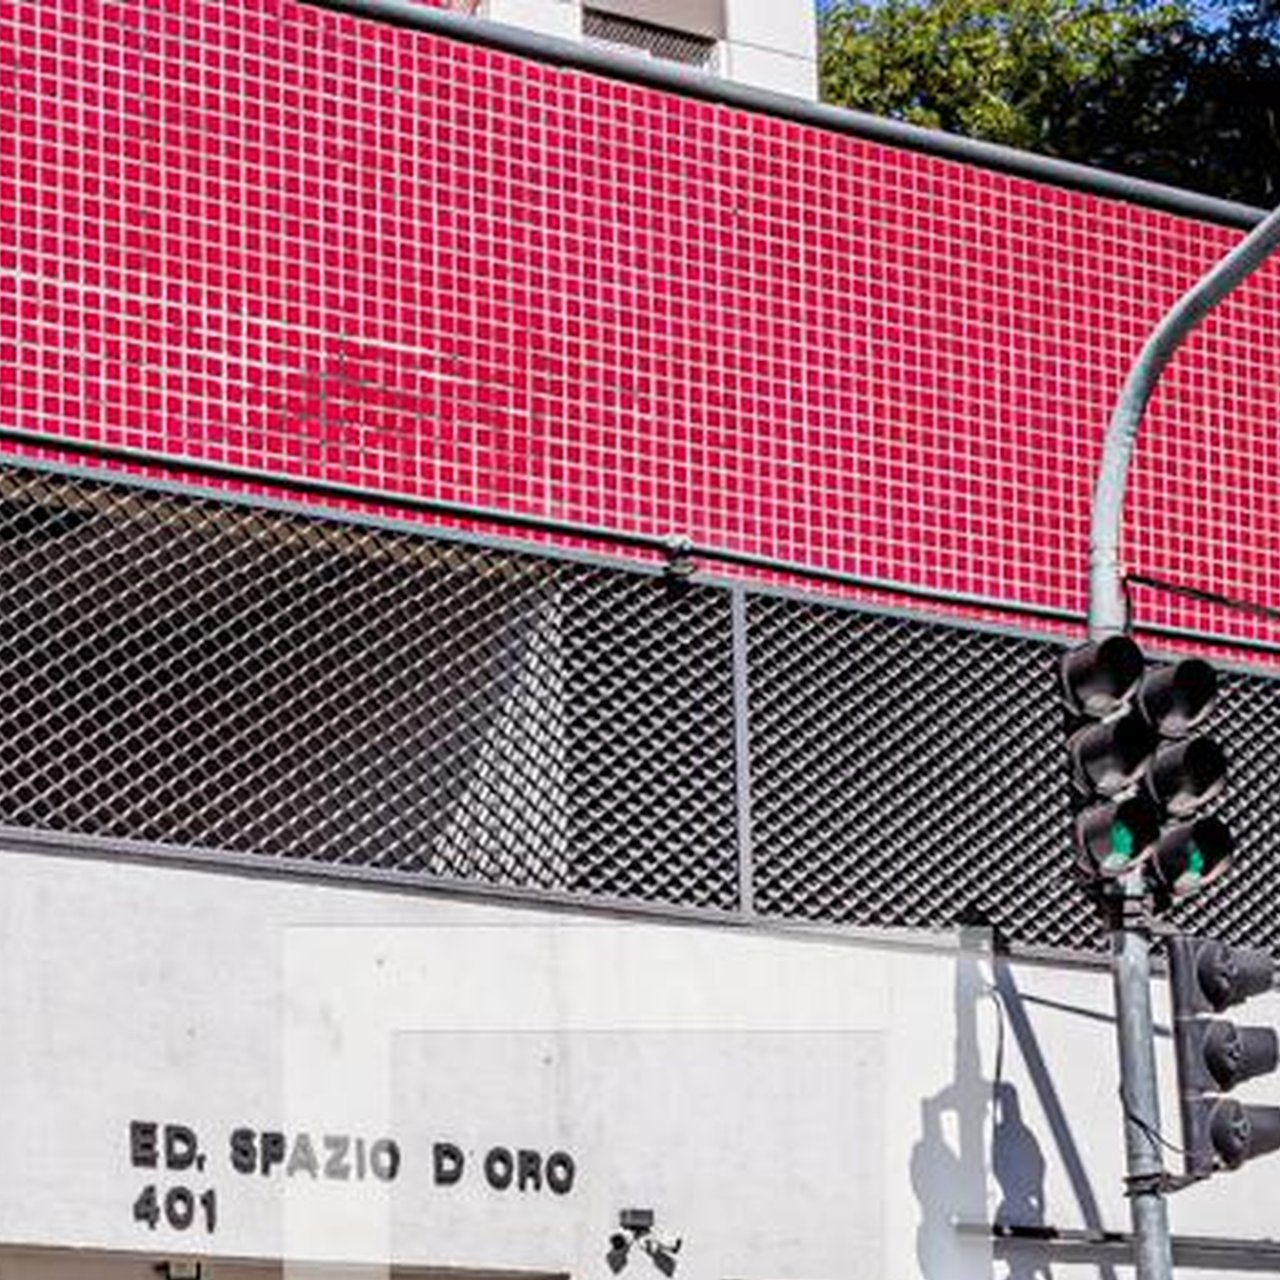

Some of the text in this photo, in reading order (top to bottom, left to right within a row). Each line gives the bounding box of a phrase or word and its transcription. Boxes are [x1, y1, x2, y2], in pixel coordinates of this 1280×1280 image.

[129, 1119, 206, 1172] ED.
[229, 1127, 401, 1182] SPAZIO
[483, 1146, 576, 1195] ORO
[132, 1184, 217, 1234] 401
